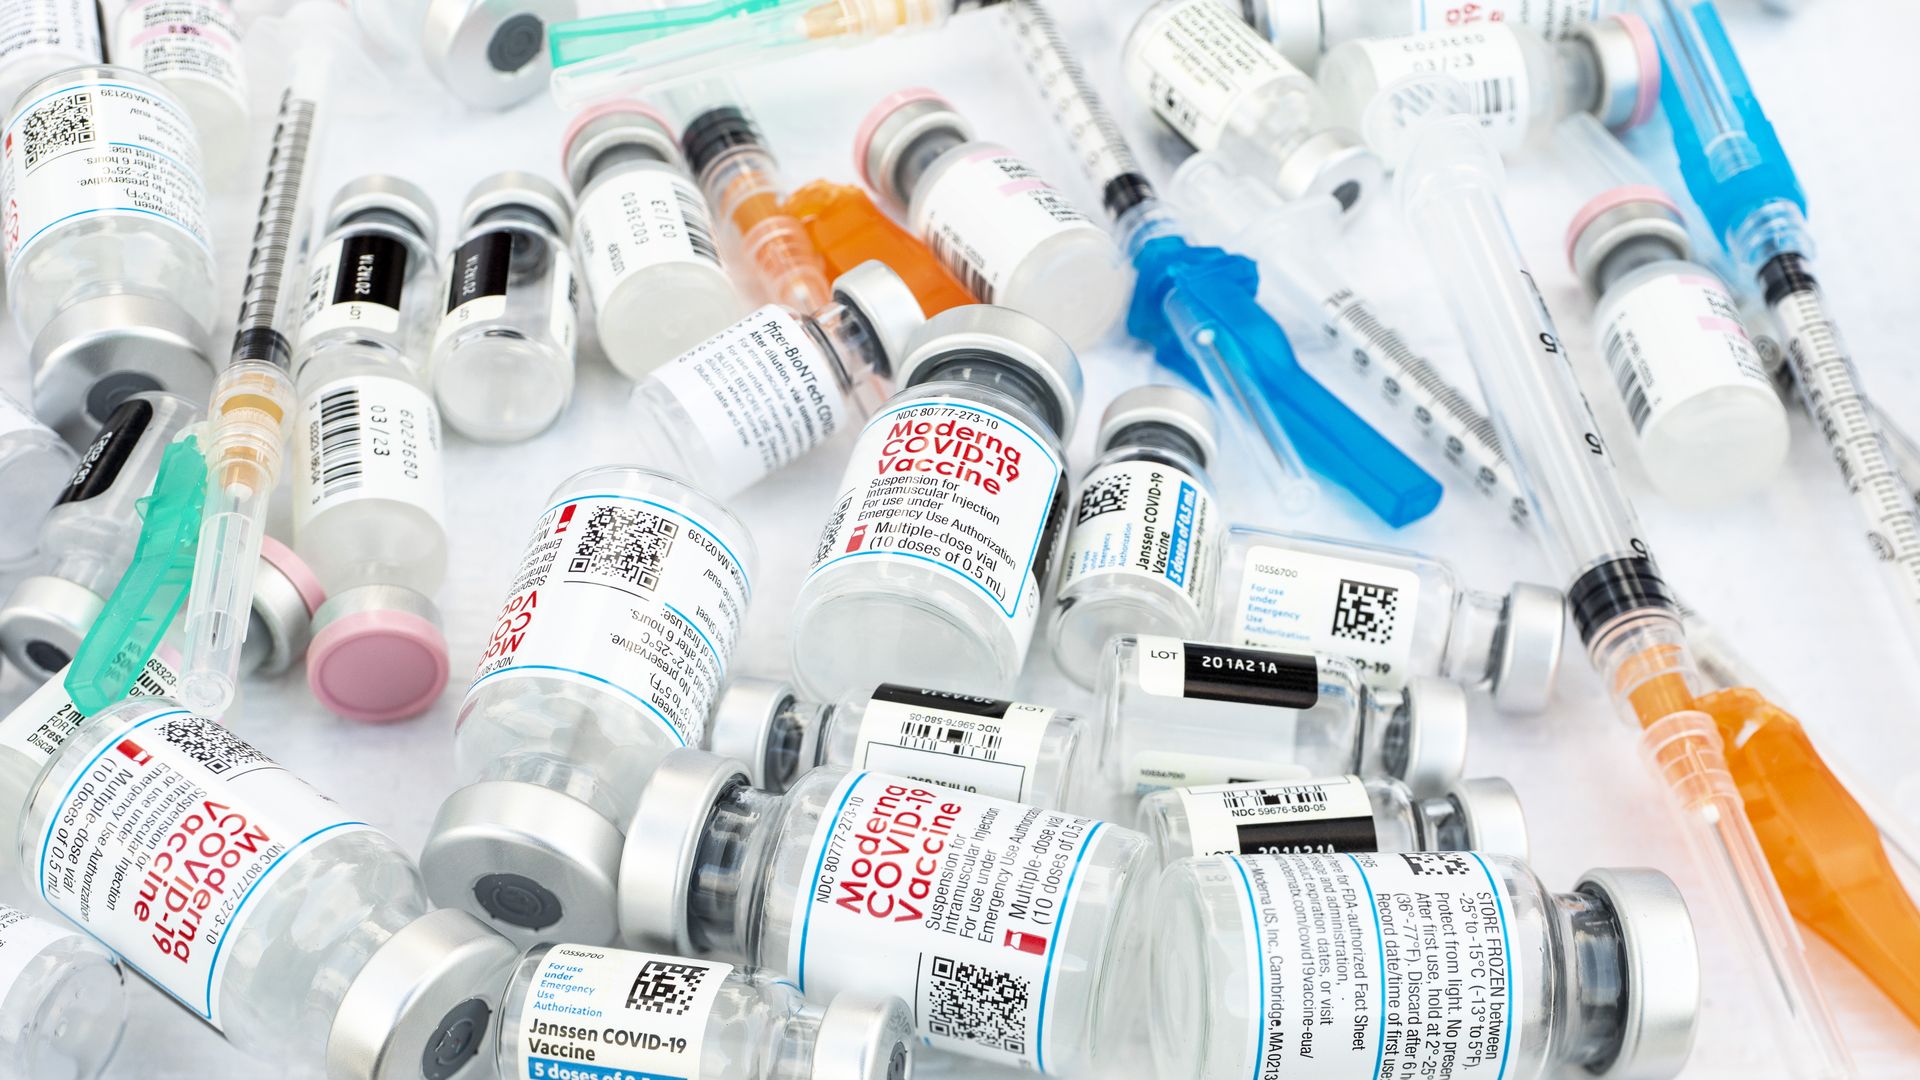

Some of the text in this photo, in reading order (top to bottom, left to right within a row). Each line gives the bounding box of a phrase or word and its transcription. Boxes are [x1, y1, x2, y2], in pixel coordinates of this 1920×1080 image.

[749, 330, 767, 349] After
[369, 404, 390, 458] 03/23
[887, 420, 1022, 466] Moderna
[896, 408, 998, 430] NDC 80777-273-10
[870, 474, 960, 492] Suspension for
[878, 456, 1001, 496] Vaccine
[882, 436, 1020, 484] COVID-19
[862, 496, 944, 510] For use under
[866, 484, 1000, 526] Intramuscular Injection
[1135, 472, 1165, 570] Janssen COVID-19
[688, 529, 731, 570] MA 02139
[858, 508, 1016, 570] Emergency Use Authorization
[875, 522, 998, 572] Multiple-dose vial
[1152, 531, 1171, 575] Vaccine
[869, 536, 1006, 602] (10 doses of 0.5 mL)
[1254, 563, 1298, 579] 10556700
[1249, 594, 1278, 606] under
[630, 608, 697, 661] after 6 hours.
[660, 607, 702, 648] first use:
[493, 656, 514, 671] NDC
[610, 632, 691, 696] No preservative.
[1150, 649, 1279, 675] LOT 201A21A
[47, 715, 69, 732] FOR
[56, 703, 71, 717] 2
[651, 692, 687, 735] between
[908, 712, 1001, 734] NDC 59676-580-05
[50, 757, 118, 872] (10 doses of 0.5
[63, 768, 134, 894] Multiple-dose vial
[116, 771, 184, 847] For use under
[137, 787, 208, 872] Suspension for
[1232, 804, 1327, 817] NDC 59676-580-05
[80, 762, 171, 922] Emergency Use Authorization
[106, 780, 196, 911] Intramuscular Injection
[134, 800, 230, 923] Vaccine
[788, 796, 864, 904] NDC 80777-273-10
[836, 784, 907, 914] Moderna
[867, 788, 937, 919] COVID-19
[894, 802, 962, 923] Vaccine
[152, 813, 247, 955] COVID-19
[173, 825, 270, 964] Moderna
[206, 842, 286, 945] NDC 80777-273-10
[925, 833, 967, 930] Suspension for
[942, 808, 1000, 934] Intramuscular Injection
[960, 849, 998, 939] For use under
[978, 844, 1019, 943] Emergency Use
[1009, 827, 1056, 920] Multiple-dose
[1032, 839, 1073, 925] (10 doses of
[1434, 892, 1457, 936] Protect
[559, 949, 605, 960] 10556700
[1307, 881, 1334, 1026] expiration dates, or visit
[1326, 894, 1348, 985] administration,
[1445, 941, 1460, 974] from
[540, 980, 595, 995] Emergency
[544, 971, 574, 981] under
[548, 962, 565, 971] For
[1342, 888, 1368, 1051] FDA-authorized Fact Sheet
[1376, 893, 1403, 1056] Record date/time of first
[1415, 892, 1443, 1037] After first use, hold at
[1476, 892, 1505, 1060] STORE FROZEN between
[533, 1001, 602, 1018] Authorization
[537, 991, 555, 1000] Use
[1267, 955, 1284, 1054] Cambridge, MA
[1444, 979, 1463, 1016] light.
[529, 1018, 687, 1054] Janssen COVID-19
[1402, 971, 1423, 1072] Discard after 6
[1446, 1019, 1462, 1038] No
[1469, 1025, 1484, 1038] to
[528, 1037, 596, 1061] Vaccine
[535, 1062, 544, 1077] 5
[1461, 1041, 1483, 1070] 5°F).
